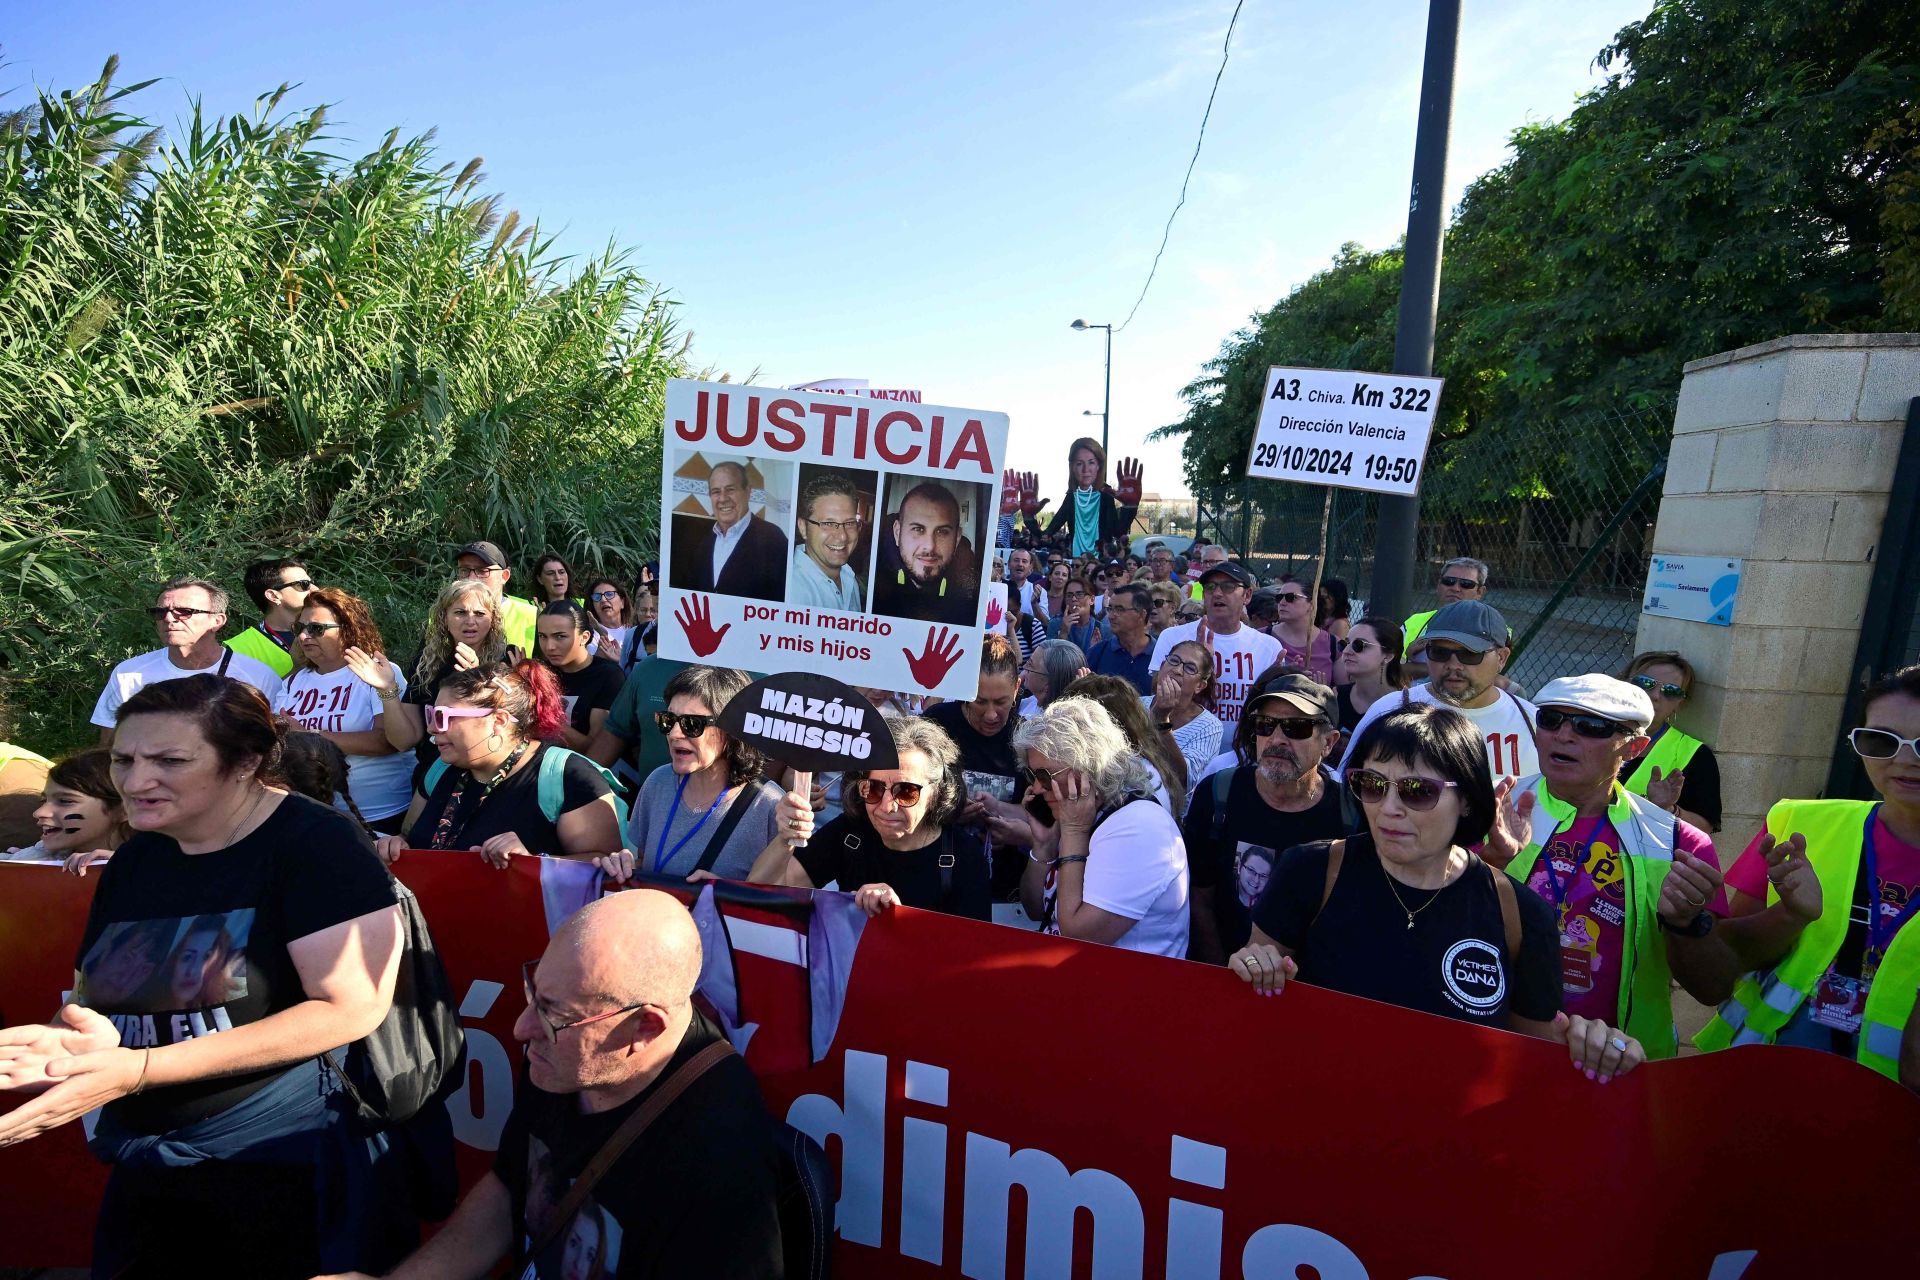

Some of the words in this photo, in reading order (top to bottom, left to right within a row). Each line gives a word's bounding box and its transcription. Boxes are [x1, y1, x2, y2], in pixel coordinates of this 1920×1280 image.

[1271, 378, 1302, 402] A3.
[1308, 389, 1346, 404] Chiva.
[1351, 383, 1384, 408] Km
[1389, 387, 1431, 412] 322
[675, 391, 994, 474] JUSTICIA
[1279, 415, 1343, 434] Dirección
[1348, 421, 1406, 441] Valencia
[1253, 443, 1354, 476] 29/10/2024
[1364, 454, 1418, 484] 19:50
[1677, 583, 1710, 593] Saviamente
[743, 604, 780, 622] por
[785, 608, 811, 626] mi
[817, 615, 893, 637] marido
[759, 633, 772, 650] y
[777, 634, 815, 653] mis
[820, 637, 872, 661] hijos
[287, 682, 353, 717] 20:11
[760, 688, 865, 731] MAZÓN
[743, 711, 873, 761] DIMISSIÓ
[1589, 906, 1622, 927] ORGULL!
[1455, 968, 1497, 987] DANA
[1457, 958, 1497, 973] VÍCTIMES
[1442, 990, 1464, 1010] JUSTICIA
[1821, 1002, 1852, 1016] Mazón
